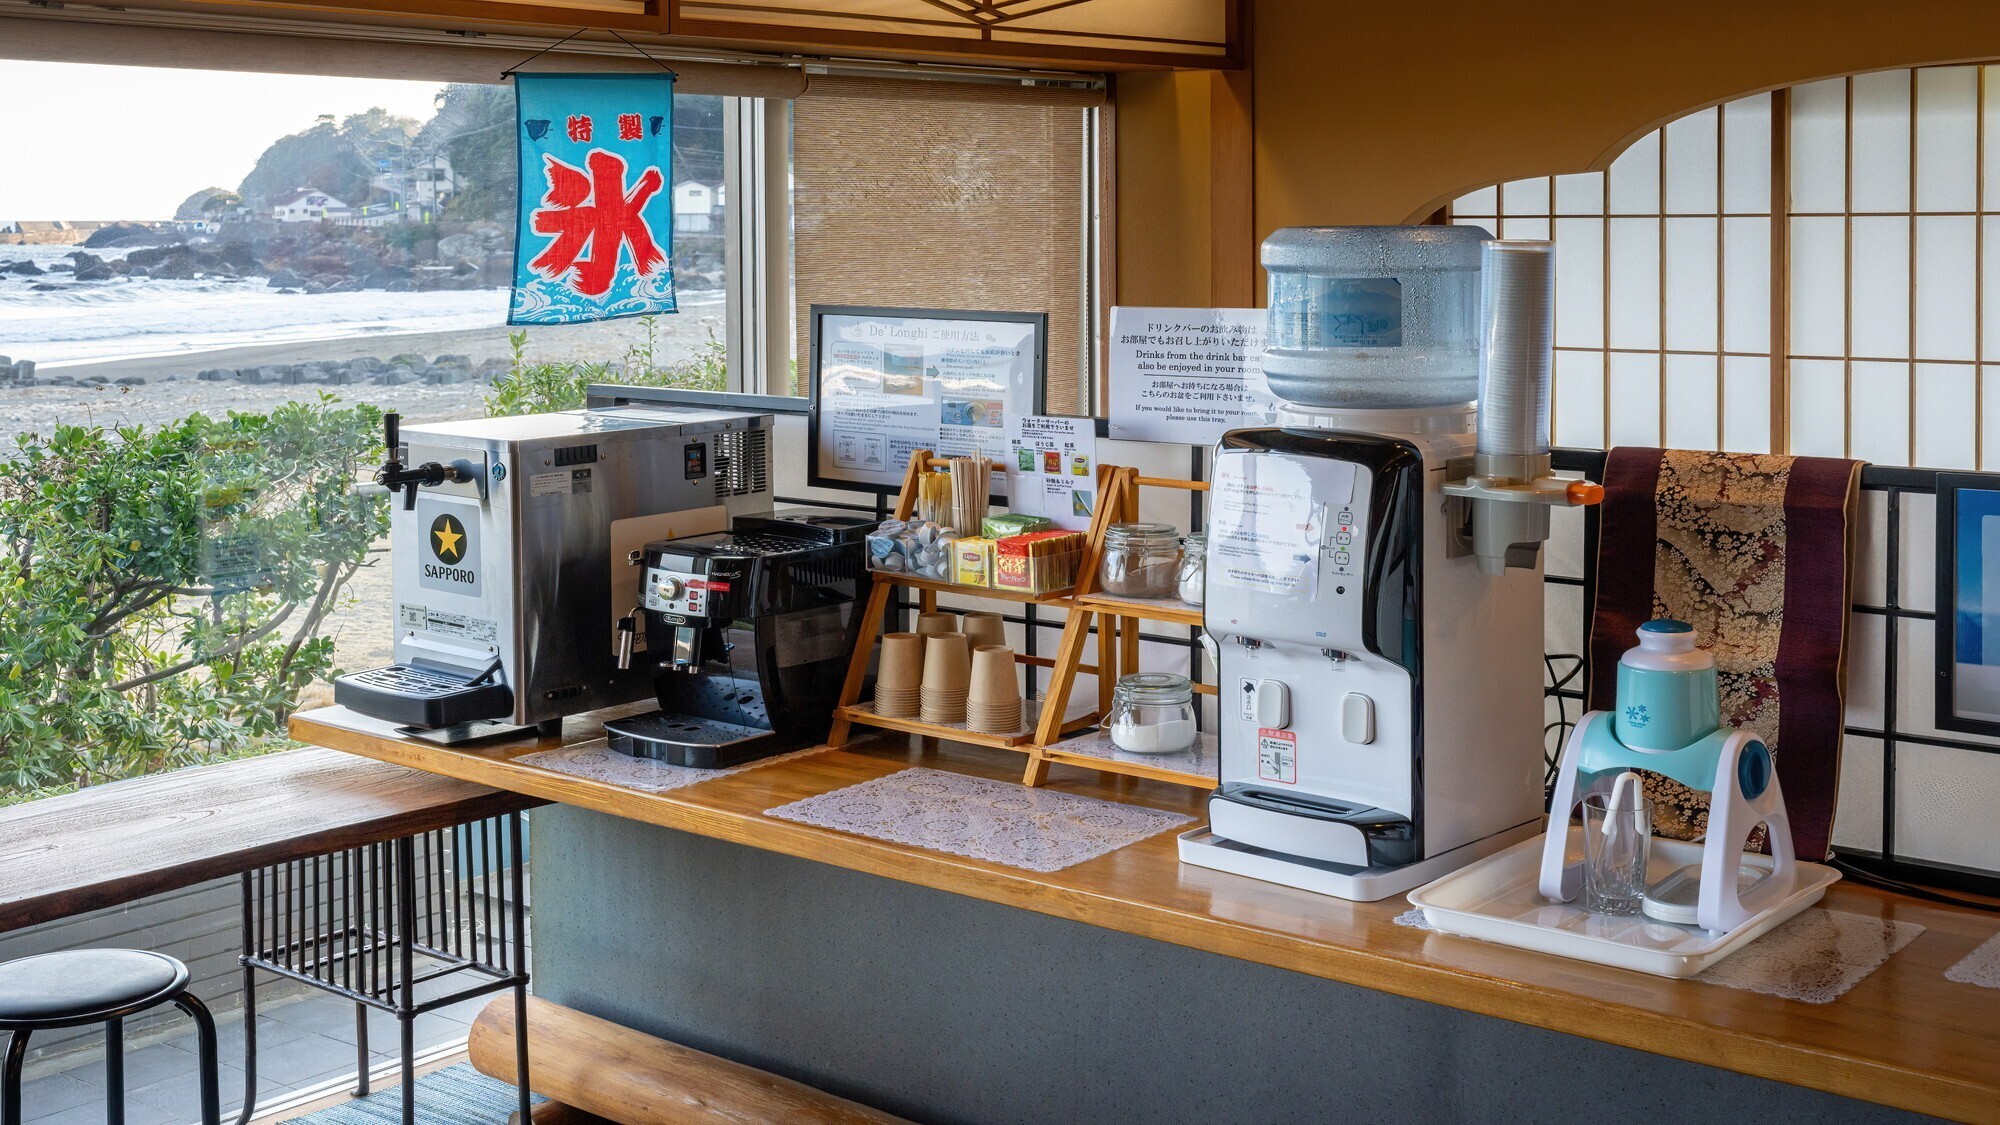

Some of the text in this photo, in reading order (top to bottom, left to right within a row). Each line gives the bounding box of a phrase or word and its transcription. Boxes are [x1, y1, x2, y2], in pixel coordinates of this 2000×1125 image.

[566, 113, 643, 143] 特製
[528, 148, 668, 297] 氷
[890, 327, 928, 340] Longhi
[932, 328, 980, 342] ご使用方法
[1148, 323, 1258, 335] ドリンクバーのお飲み物は
[1136, 350, 1263, 363] Drinks from the drink bar ca
[1137, 361, 1264, 374] also be enjoyed in your room.
[1151, 381, 1249, 392] お部屋へお持ちになる場合は
[1141, 390, 1257, 402] こちらのお盆をご利用下さいませ。
[1193, 407, 1210, 415] bring
[1022, 418, 1070, 427] ウォーターサーバーの
[424, 564, 475, 585] SAPPORO
